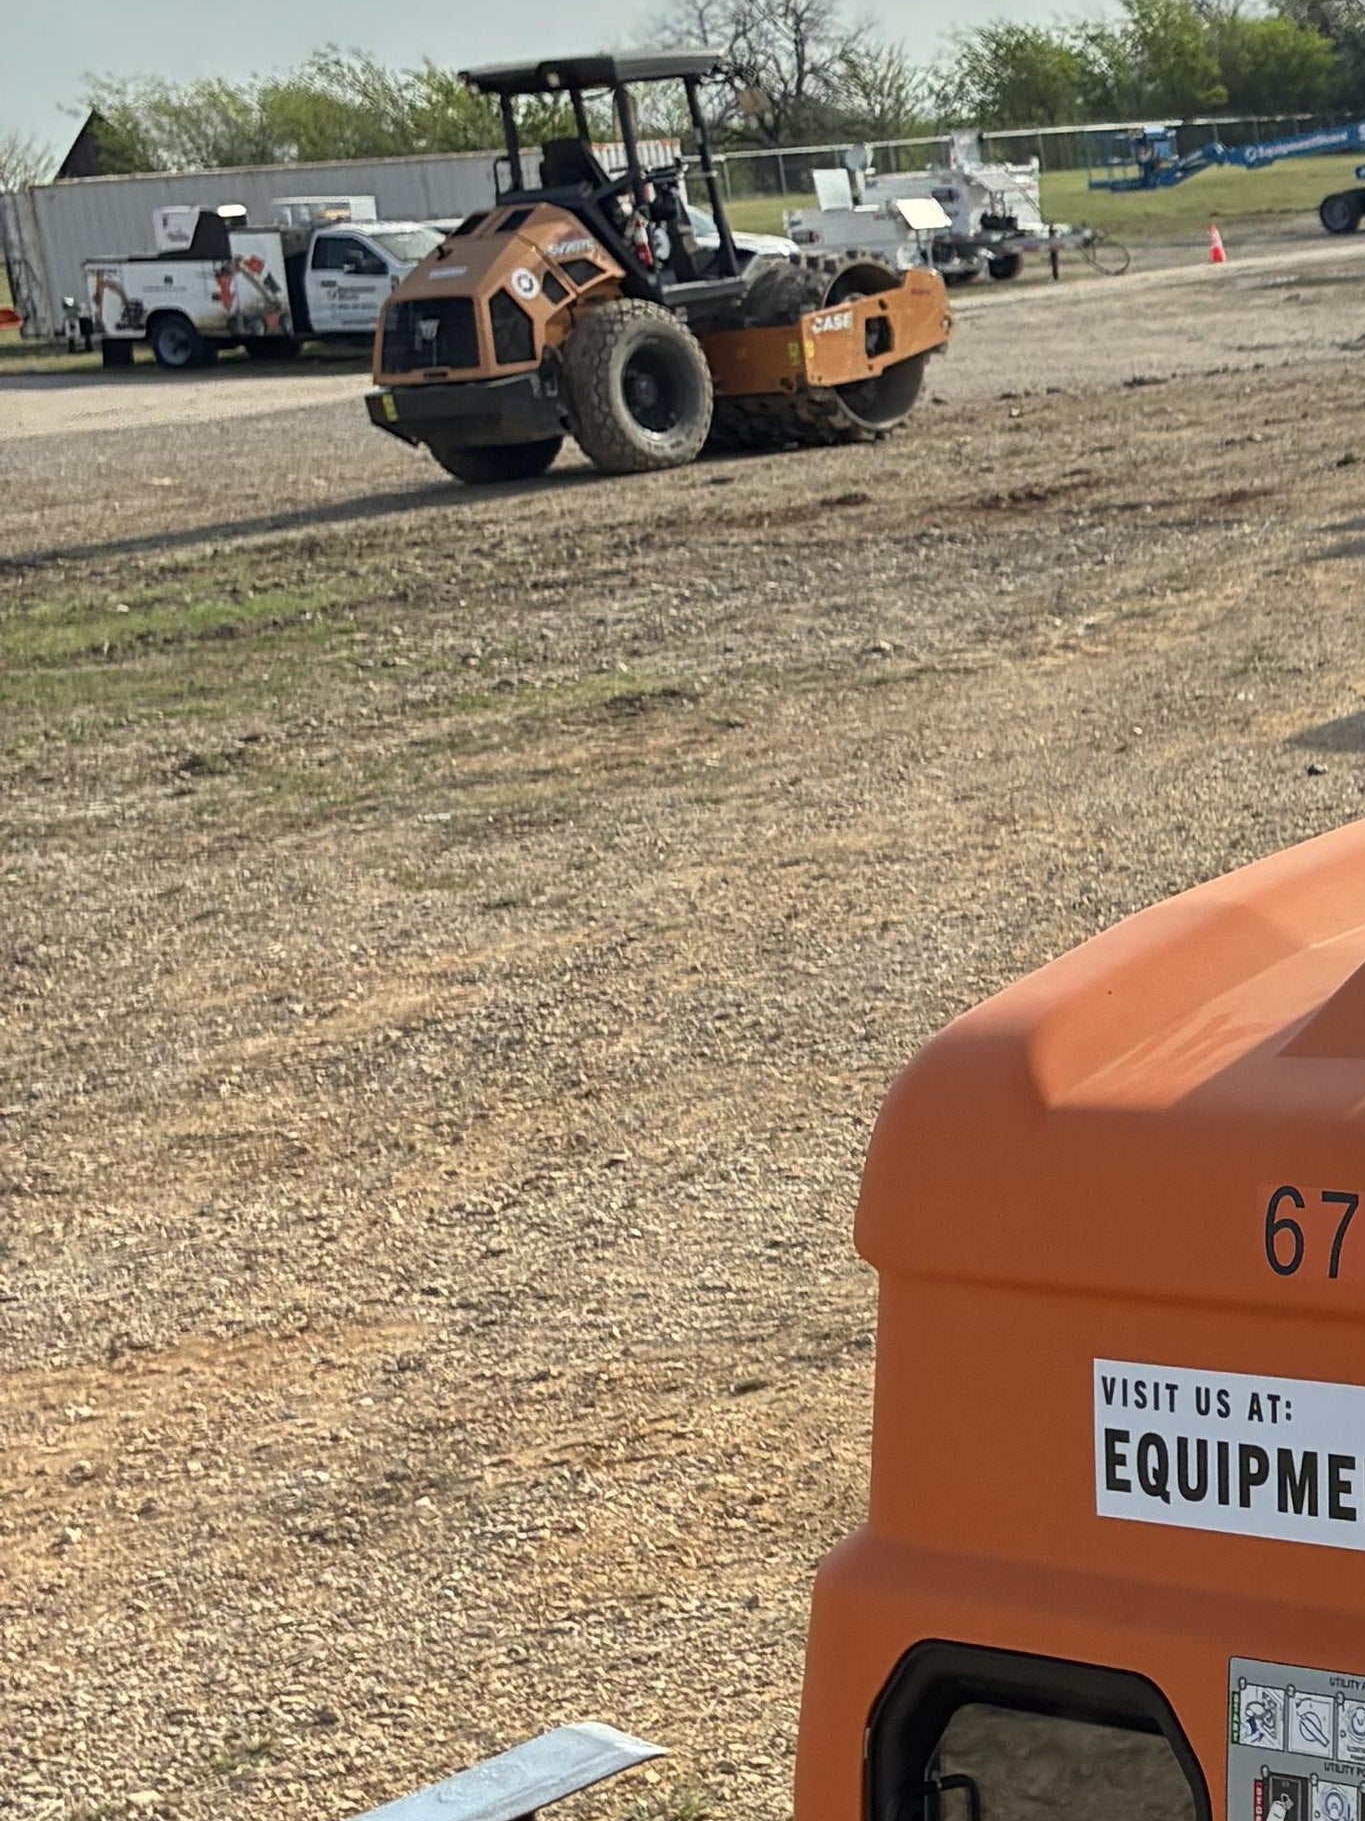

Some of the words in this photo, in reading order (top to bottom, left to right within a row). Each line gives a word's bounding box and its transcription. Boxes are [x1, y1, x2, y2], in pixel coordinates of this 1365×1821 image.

[1101, 1375, 1179, 1413] VISIT
[1195, 1385, 1231, 1419] US
[1247, 1392, 1292, 1424] AT:
[1329, 1676, 1361, 1693] UTILITY
[1324, 1762, 1353, 1778] UTILITY
